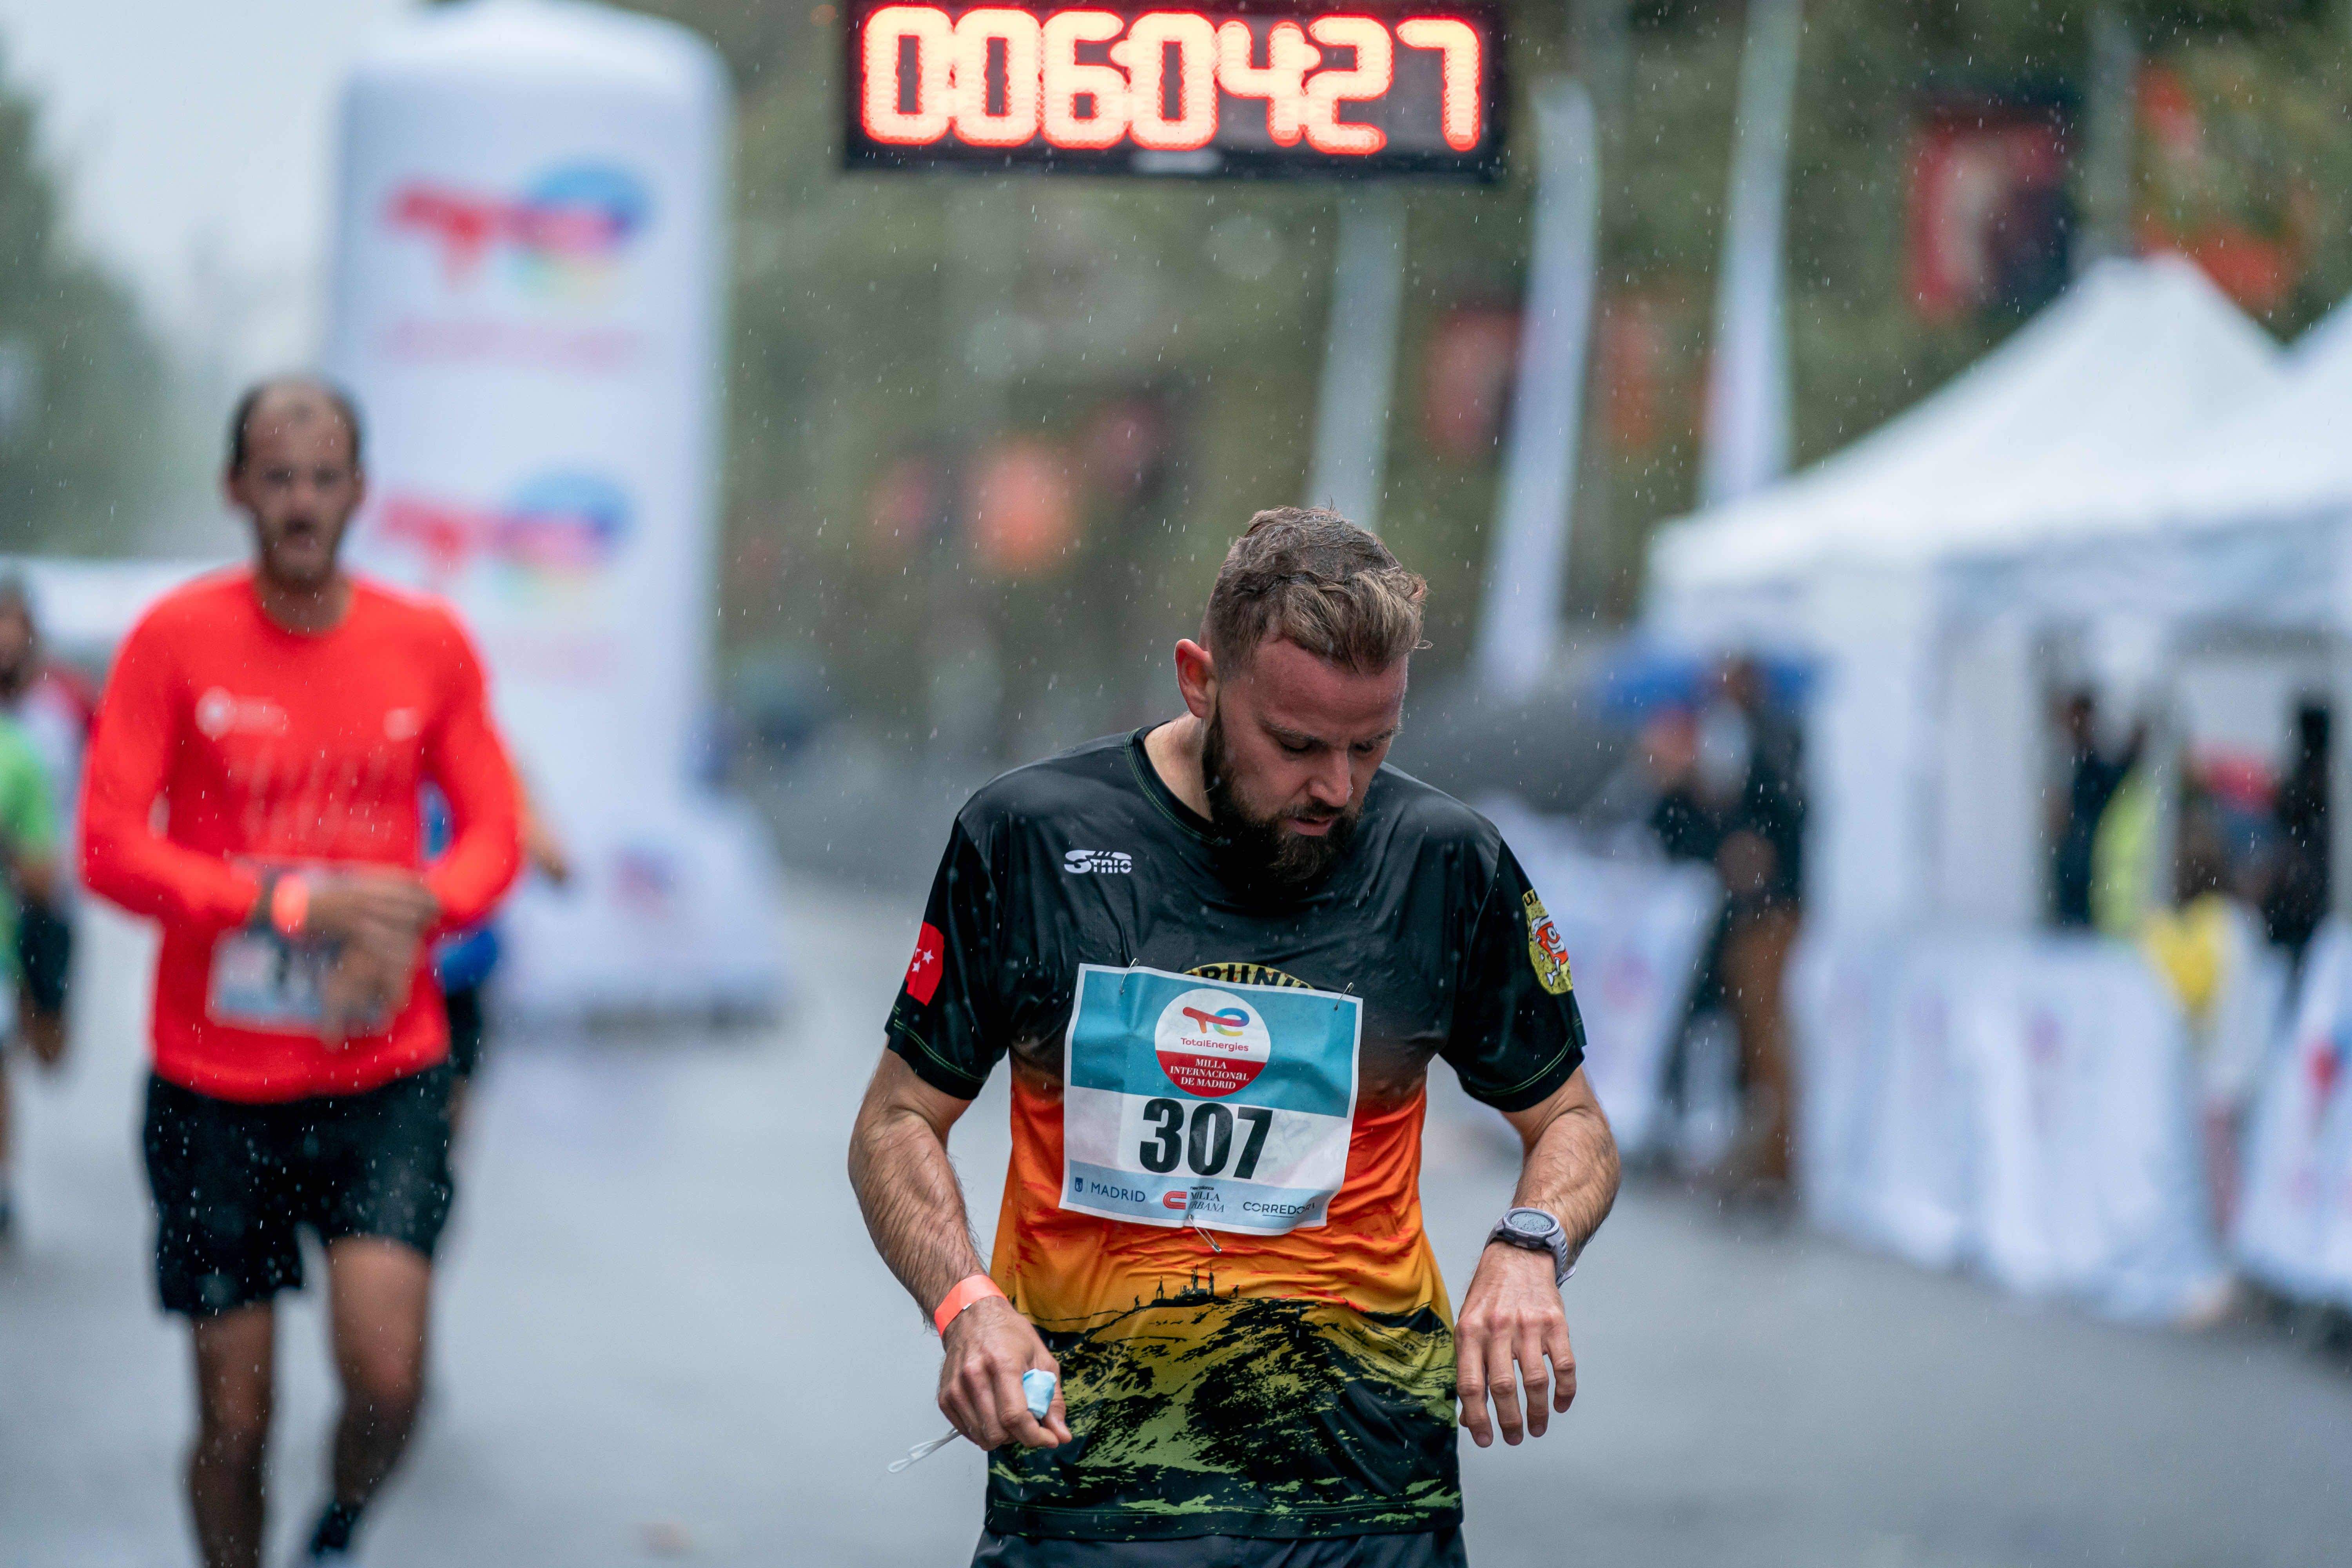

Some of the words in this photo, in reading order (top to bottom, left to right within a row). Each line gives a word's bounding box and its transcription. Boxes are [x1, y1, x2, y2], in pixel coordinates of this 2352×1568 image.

[1180, 1038, 1249, 1052] TotalEnergies
[1196, 1058, 1227, 1069] MILLA
[1181, 1077, 1194, 1086] DE
[1197, 1078, 1236, 1089] MADRID
[1139, 1098, 1273, 1180] 307
[1091, 1181, 1146, 1202] MADRID
[1191, 1191, 1220, 1202] MILLA
